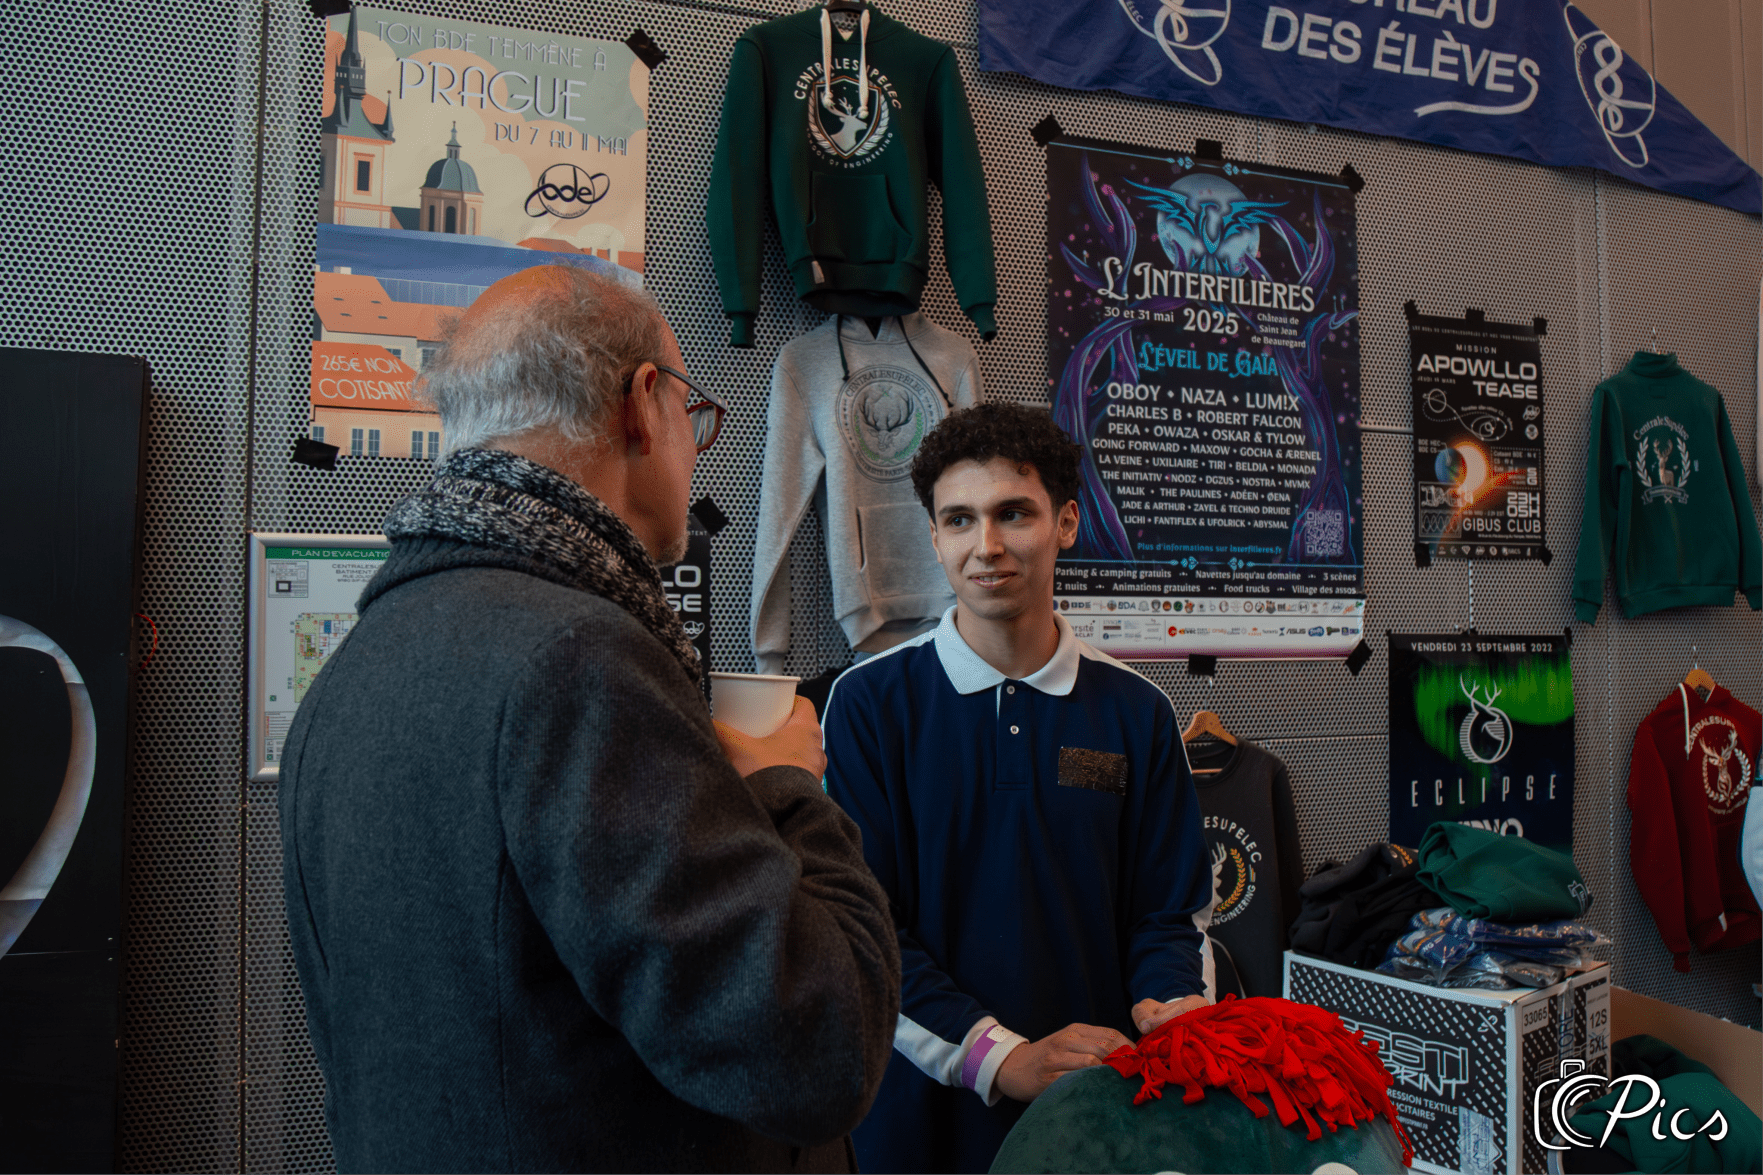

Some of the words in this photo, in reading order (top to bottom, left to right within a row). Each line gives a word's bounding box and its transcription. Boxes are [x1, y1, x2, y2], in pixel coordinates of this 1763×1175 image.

[376, 21, 422, 46] TON
[433, 29, 476, 54] BDE
[488, 36, 583, 68] T'EMMÈNE
[594, 47, 608, 71] À
[1261, 5, 1362, 64] DES
[1372, 20, 1541, 116] ÉLÈVES
[397, 57, 587, 122] PRAGUE
[794, 57, 902, 110] CENTRLESPELEC
[495, 123, 520, 142] DU
[530, 127, 540, 145] 7
[551, 130, 574, 148] AU
[598, 136, 628, 156] MAI
[1104, 306, 1120, 318] 30
[1123, 308, 1135, 319] et
[1137, 309, 1150, 321] 31
[1153, 311, 1175, 323] mai
[1183, 307, 1241, 335] 2025
[1257, 312, 1288, 325] Château
[1290, 317, 1300, 326] de
[1259, 324, 1279, 335] Saint
[1281, 328, 1298, 337] Jean
[1251, 335, 1262, 344] de
[1263, 336, 1307, 349] Beauregard
[1456, 343, 1497, 354] MISSION
[320, 354, 363, 373] 265€
[364, 356, 404, 374] NON
[1206, 352, 1229, 372] DE
[1417, 353, 1538, 381] APOWLLO
[1107, 382, 1161, 402] OBOY
[1181, 386, 1227, 407] NAZA
[1246, 391, 1300, 412] LUM!X
[1472, 380, 1538, 400] TEASE
[1106, 404, 1169, 420] CHARLES
[1172, 408, 1182, 422] B
[1197, 409, 1249, 426] ROBERT
[1252, 413, 1302, 430] FALCON
[1108, 422, 1141, 436] PEKA
[1153, 424, 1200, 440] OWAZA
[1211, 428, 1251, 443] OSKAR
[1253, 430, 1263, 444] &
[1265, 432, 1307, 446] TYLOW
[1092, 437, 1126, 450] GOING
[1128, 440, 1181, 453] FORWARD
[1190, 443, 1231, 456] MAXOW
[1240, 446, 1274, 458] GOCHA
[1275, 448, 1283, 459] &
[1285, 449, 1322, 461] ÆRENEL
[1098, 454, 1112, 465] LA
[1113, 455, 1143, 466] VEINE
[1152, 457, 1199, 469] UXILIAIRE
[1208, 459, 1226, 470] TIRI
[1235, 461, 1269, 472] BELDIA
[1277, 463, 1317, 475] MONADA
[1101, 470, 1120, 481] THE
[1122, 470, 1163, 482] INITIATIV
[1171, 474, 1197, 484] NODZ
[1205, 475, 1234, 486] DGZUS
[1242, 477, 1277, 488] NOSTRA
[1284, 479, 1311, 489] MVMX
[1116, 485, 1146, 496] MALIK
[1159, 487, 1178, 497] THE
[1180, 488, 1222, 499] PAULINES
[1230, 489, 1259, 501] ADÉEN
[1267, 492, 1291, 503] ØENA
[1507, 491, 1540, 505] 23H
[1121, 500, 1142, 510] JADE
[1144, 501, 1151, 510] &
[1152, 501, 1186, 511] ARTHUR
[1193, 502, 1219, 513] ZAYEL
[1220, 504, 1227, 513] &
[1228, 504, 1260, 515] TECHNO
[1261, 506, 1291, 516] DRUIDE
[1124, 515, 1146, 525] LICHI
[1153, 515, 1197, 526] FANTIFLEX
[1198, 517, 1205, 526] &
[1207, 518, 1246, 528] UFOLRICK
[1253, 519, 1290, 530] ABYSMAL
[1462, 517, 1501, 532] GIBUS
[1507, 518, 1541, 533] CLUB
[1137, 542, 1154, 551] Plus
[1055, 567, 1089, 578] Parking
[1090, 568, 1098, 577] &
[1100, 569, 1137, 579] camping
[1139, 569, 1172, 579] gratuits
[1195, 570, 1231, 579] Navettes
[1232, 571, 1265, 581] jusqu'au
[1267, 571, 1301, 580] domaine
[1323, 572, 1329, 581] 3
[1330, 572, 1357, 582] scènes
[1056, 582, 1063, 590] 2
[1065, 582, 1088, 591] nuits
[1112, 582, 1162, 592] Animations
[1163, 583, 1201, 594] gratuites
[1224, 584, 1244, 593] Food
[1245, 584, 1270, 593] trucks
[1291, 585, 1318, 596] Village
[1319, 585, 1333, 594] des
[1335, 586, 1357, 595] assos
[1411, 642, 1457, 652] VENDREDI
[1461, 642, 1472, 653] 23
[1476, 642, 1527, 653] SEPTEMBRE
[1531, 642, 1553, 653] 2022
[1411, 774, 1556, 808] ECLIPSE
[1203, 816, 1262, 864] ESUPELEC
[1523, 1006, 1547, 1027] 33065
[1590, 1008, 1607, 1029] 12S
[1558, 1008, 1574, 1060] TORE
[1589, 1035, 1607, 1055] 5XL
[1386, 1087, 1422, 1106] RESSION
[1423, 1097, 1459, 1116] TEXTILE
